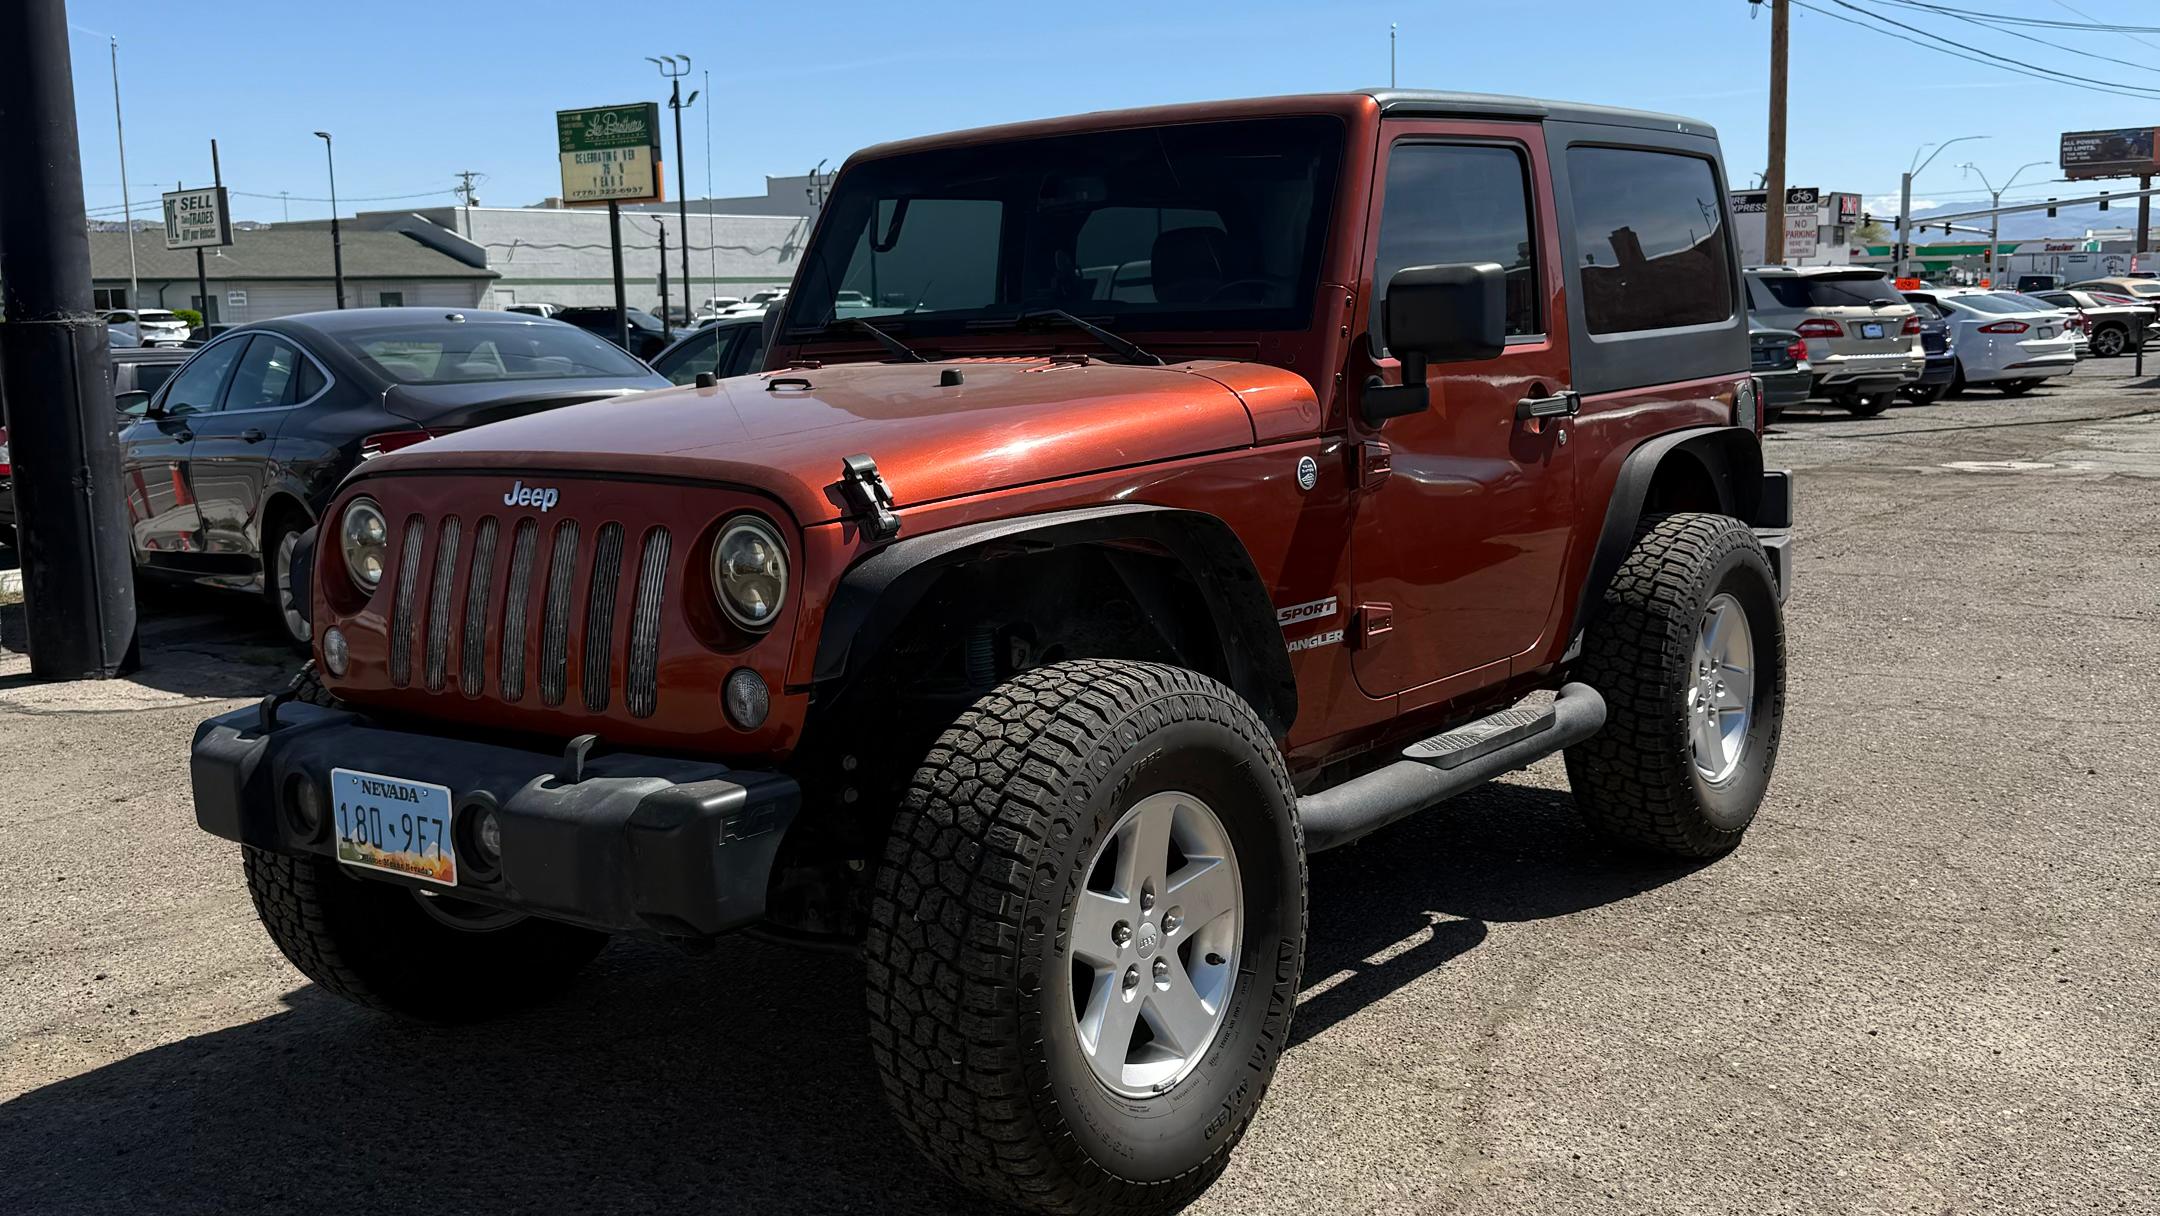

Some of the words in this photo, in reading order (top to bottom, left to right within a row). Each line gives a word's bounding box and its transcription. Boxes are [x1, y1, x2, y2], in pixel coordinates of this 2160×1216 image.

[180, 194, 213, 211] SELL
[1732, 203, 1767, 212] XPRESS
[189, 211, 215, 225] TRADES
[1794, 219, 1807, 228] NO
[1785, 230, 1817, 238] PARKING
[503, 480, 559, 512] Jeep
[1279, 600, 1336, 621] SPORT
[1286, 629, 1345, 652] ANGLER
[361, 780, 420, 803] NEVADA
